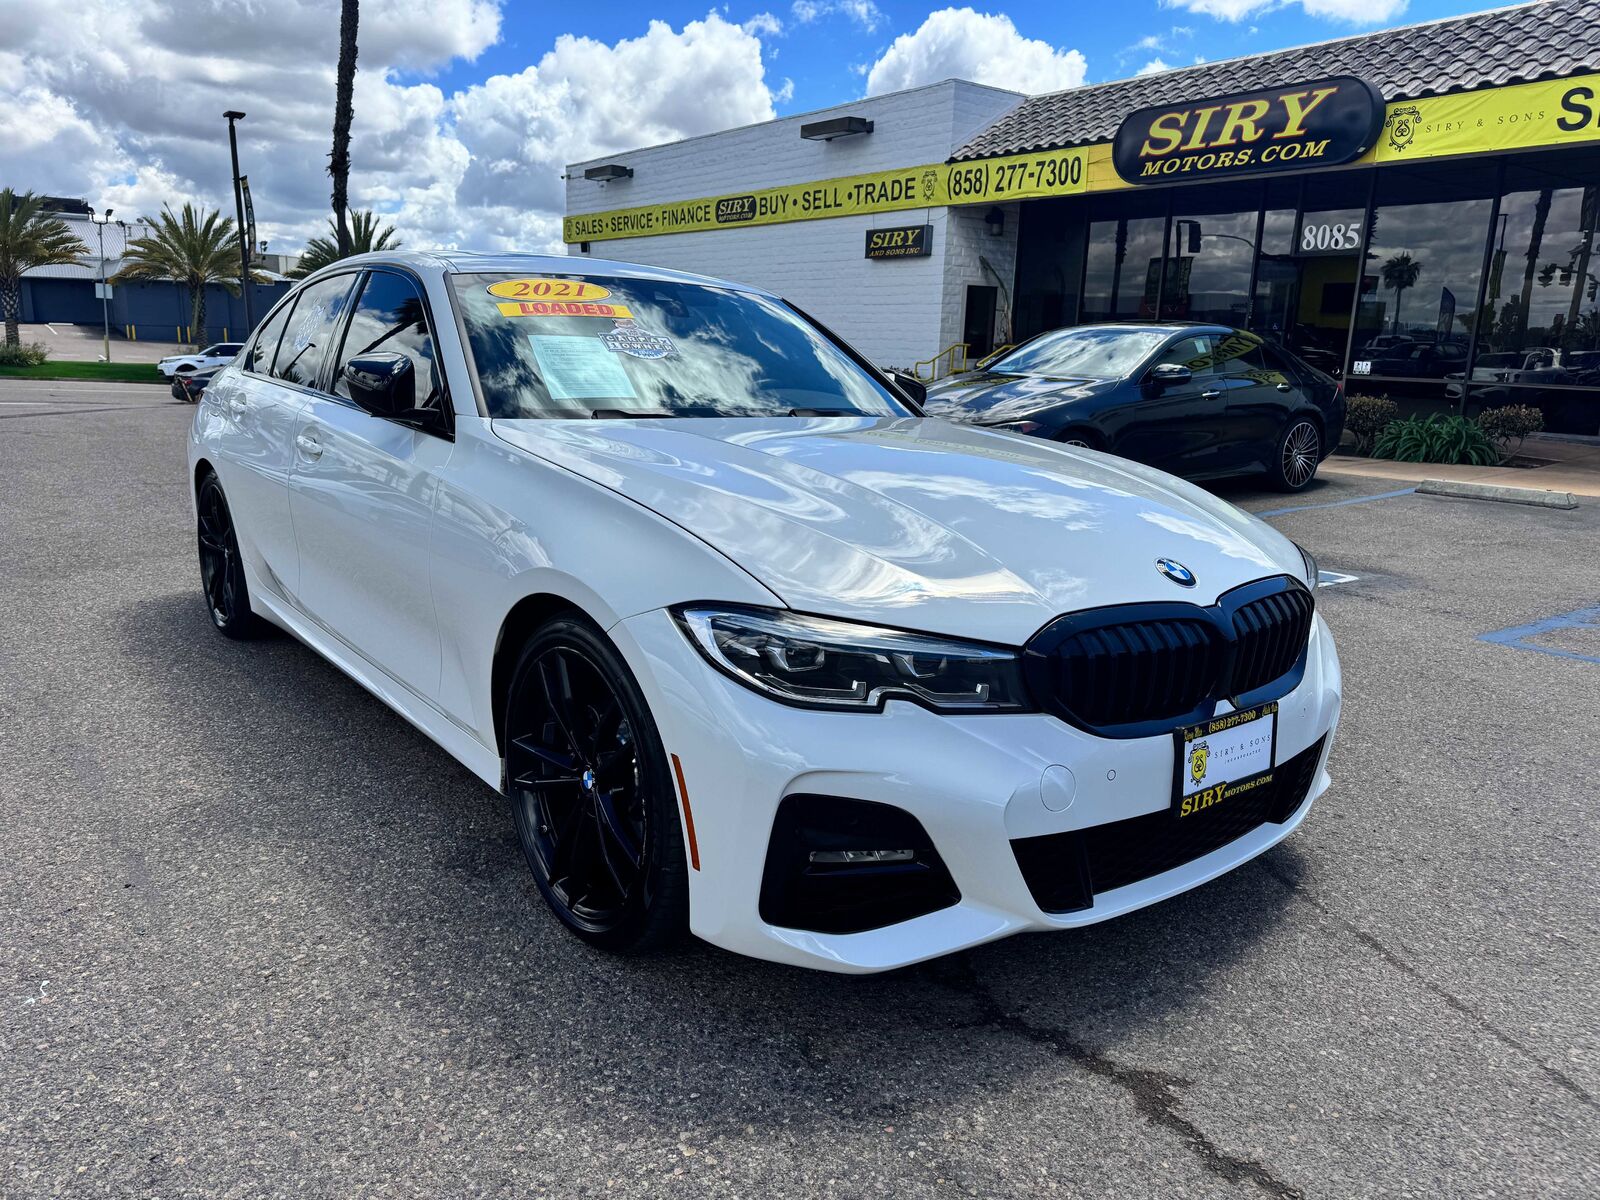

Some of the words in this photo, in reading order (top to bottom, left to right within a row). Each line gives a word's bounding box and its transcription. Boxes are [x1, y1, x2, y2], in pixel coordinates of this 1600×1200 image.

[1139, 86, 1339, 158] SIRY
[1425, 120, 1465, 133] SIRY
[1477, 119, 1484, 127] &
[1497, 110, 1545, 125] SONS
[1556, 86, 1600, 132] S
[1140, 139, 1330, 177] MOTORS.COM
[946, 163, 989, 201] (858)
[994, 156, 1082, 194] 277-7300
[718, 198, 754, 215] SIRY
[759, 193, 789, 216] BUY
[802, 188, 843, 212] SELL
[854, 177, 916, 204] TRADE
[575, 217, 605, 236] SALES
[610, 212, 653, 233] SERVICE
[661, 204, 711, 227] FINANCE
[870, 230, 921, 248] SIRY
[1302, 223, 1361, 251] 8085
[885, 248, 905, 256] SONS
[905, 247, 920, 255] INC
[512, 282, 586, 297] 2021
[519, 302, 615, 317] LOADED
[1214, 746, 1235, 759] SIRY
[1250, 735, 1271, 748] SONS
